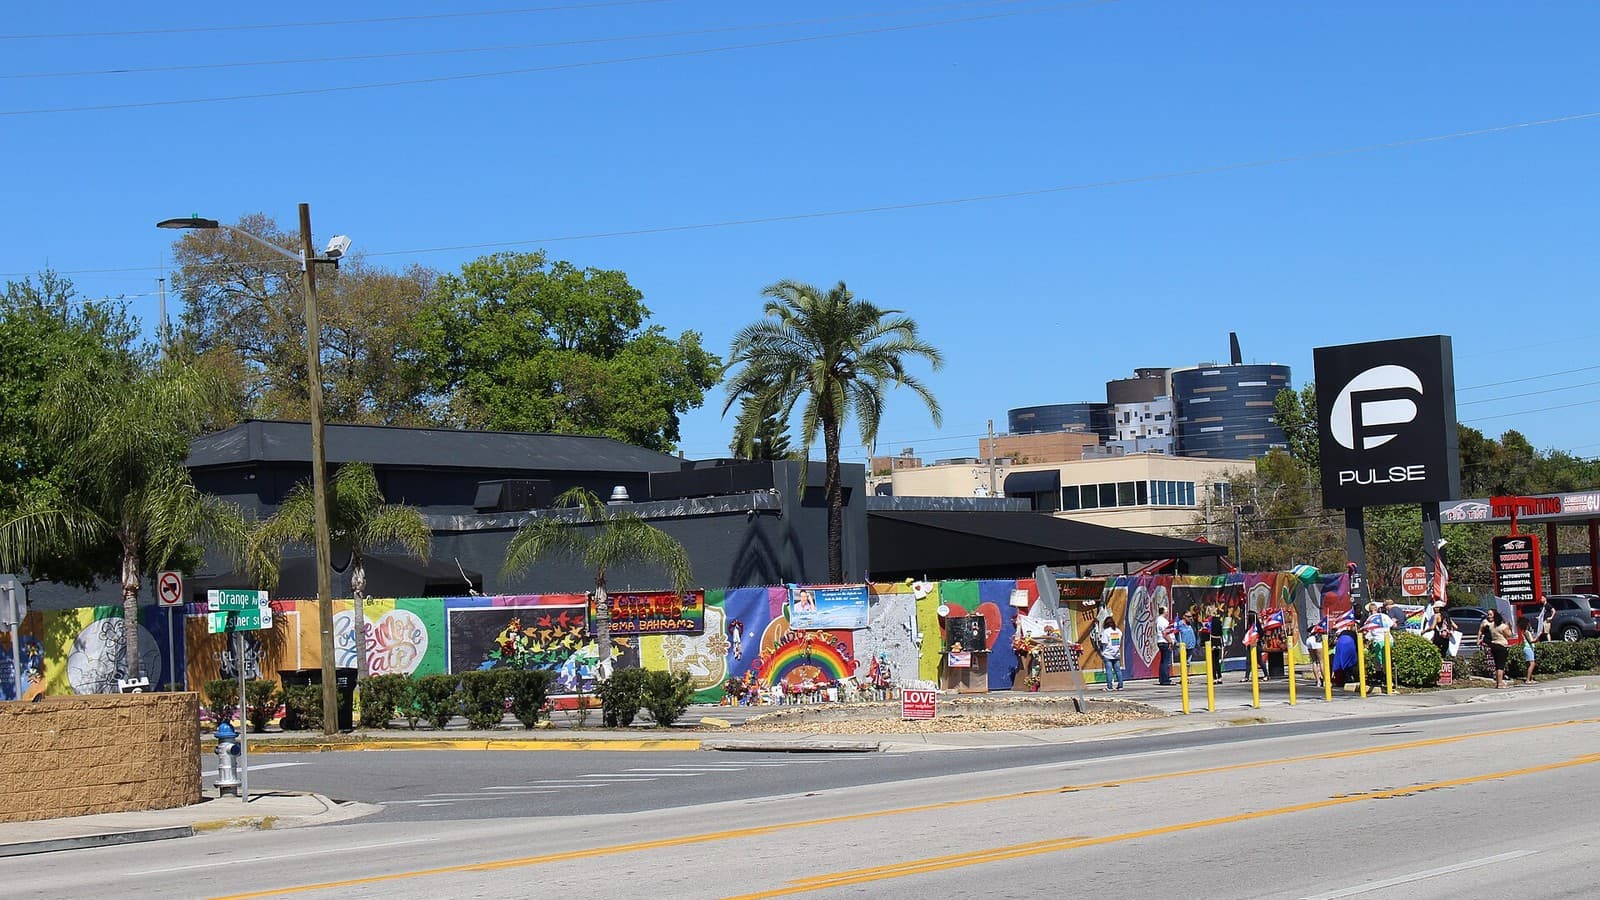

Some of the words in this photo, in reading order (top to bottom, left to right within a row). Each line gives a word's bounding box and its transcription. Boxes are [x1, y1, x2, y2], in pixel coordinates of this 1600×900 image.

[1339, 465, 1426, 486] PULSE
[220, 592, 249, 608] Orange
[1441, 663, 1452, 673] OVE
[904, 692, 935, 704] LOVE
